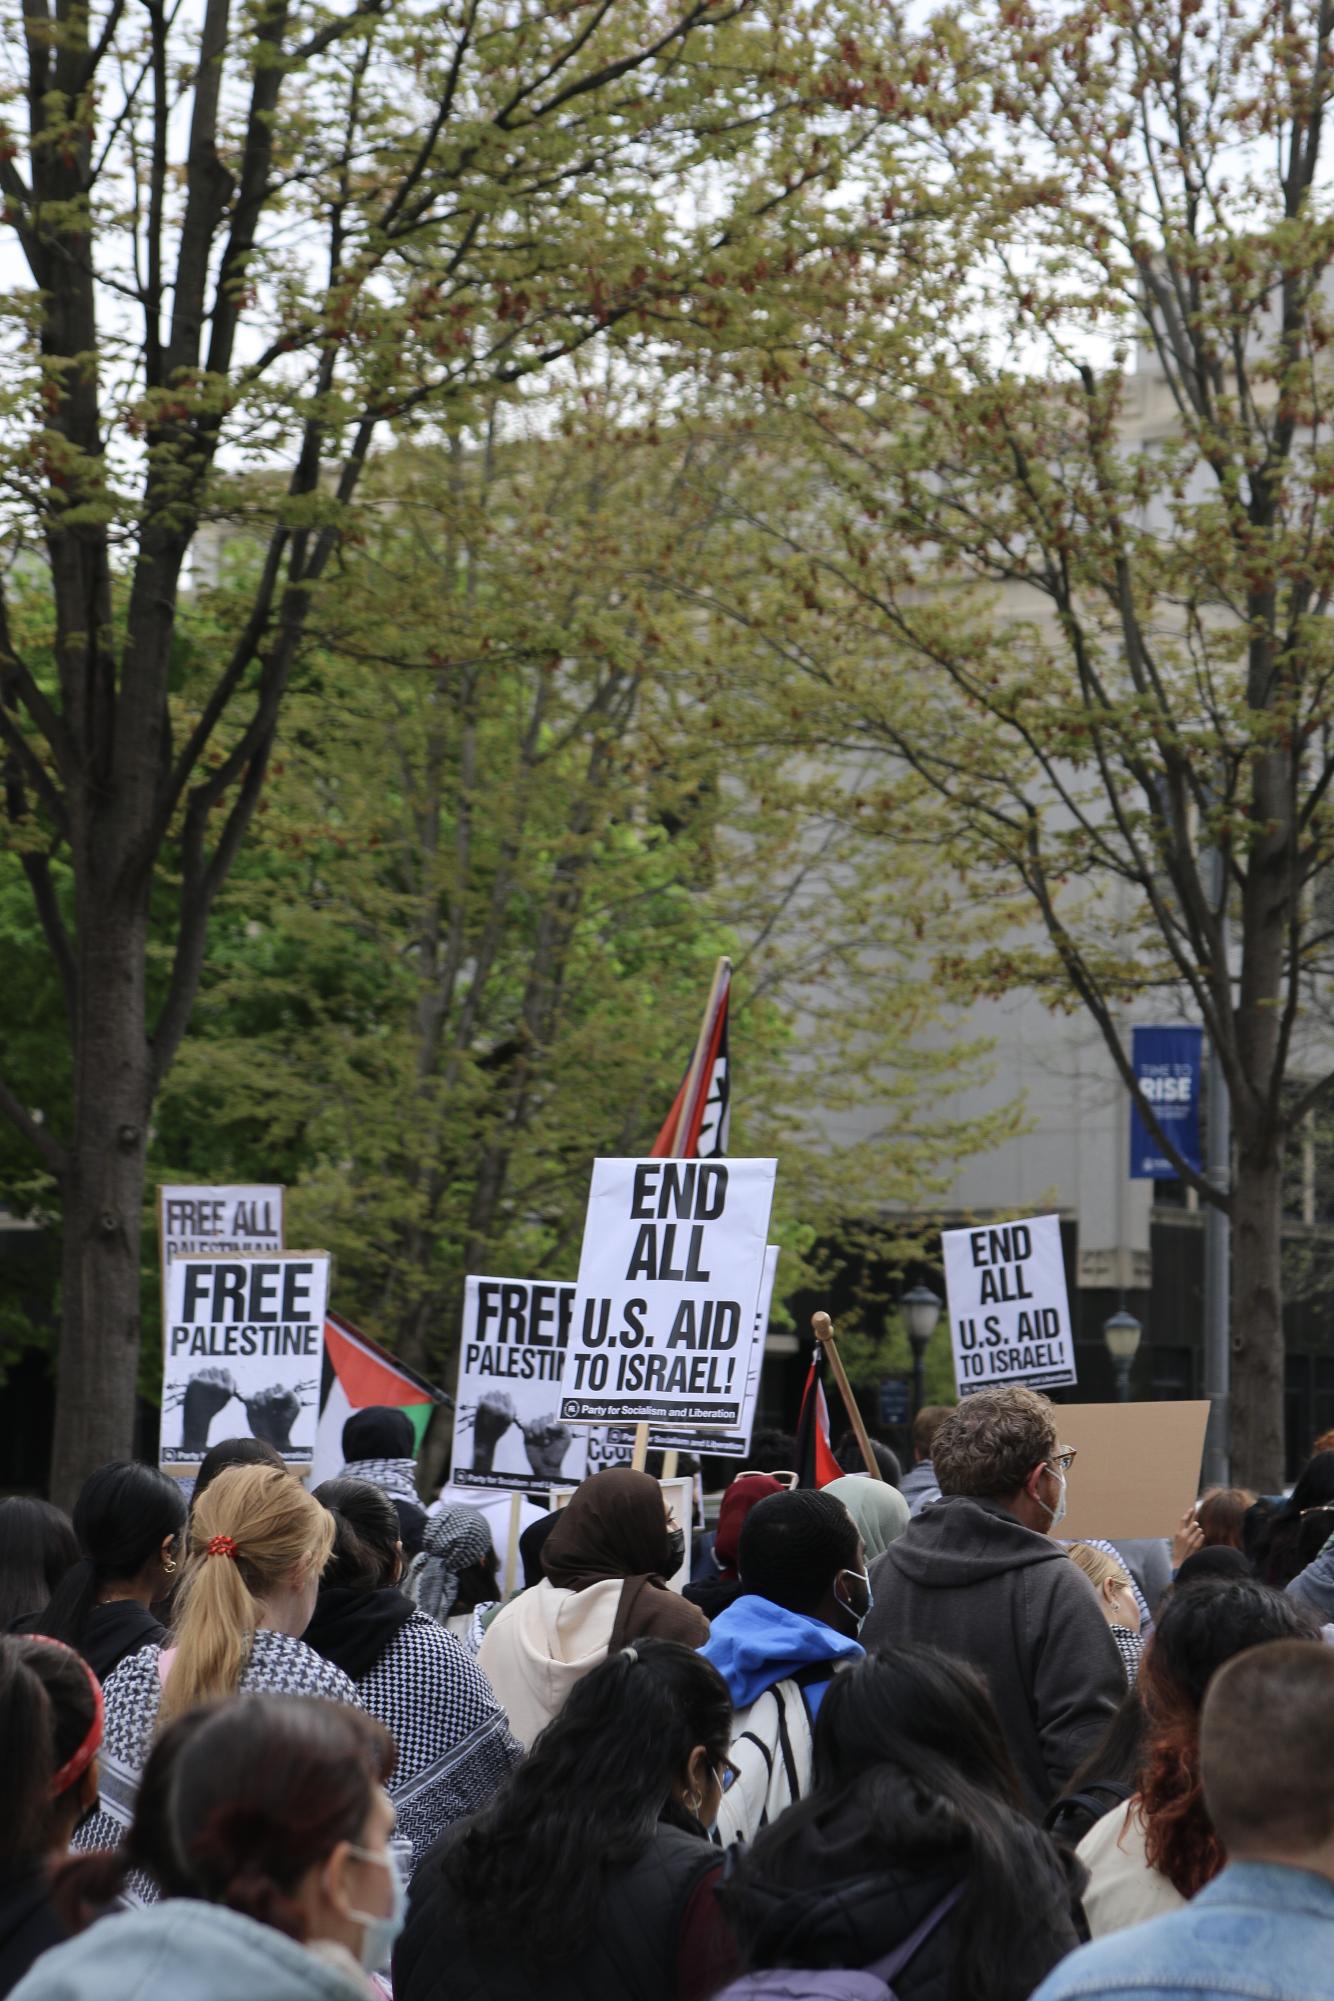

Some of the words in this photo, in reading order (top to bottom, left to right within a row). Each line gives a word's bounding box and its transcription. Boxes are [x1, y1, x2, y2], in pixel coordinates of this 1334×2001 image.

[1139, 1077, 1192, 1101] RISE
[630, 1163, 729, 1221] END
[166, 1199, 226, 1236] FREE
[232, 1200, 277, 1237] ALL
[625, 1223, 710, 1282] ALL
[971, 1225, 1032, 1267] END
[182, 1263, 313, 1323] FREE
[980, 1264, 1033, 1305] ALL
[171, 1325, 319, 1356] PALESTINE
[582, 1298, 654, 1349] U.S.
[666, 1300, 741, 1350] AID
[959, 1315, 1009, 1350] U.S.
[1018, 1308, 1060, 1343] AID
[574, 1353, 609, 1391] TO
[616, 1353, 736, 1394] ISRAEL!
[960, 1352, 984, 1377] TO
[990, 1342, 1065, 1374] ISRAEL!
[581, 1405, 607, 1417] Party
[608, 1405, 621, 1415] for
[621, 1405, 667, 1416] Socialism
[668, 1408, 687, 1417] and
[688, 1408, 736, 1419] Liberation
